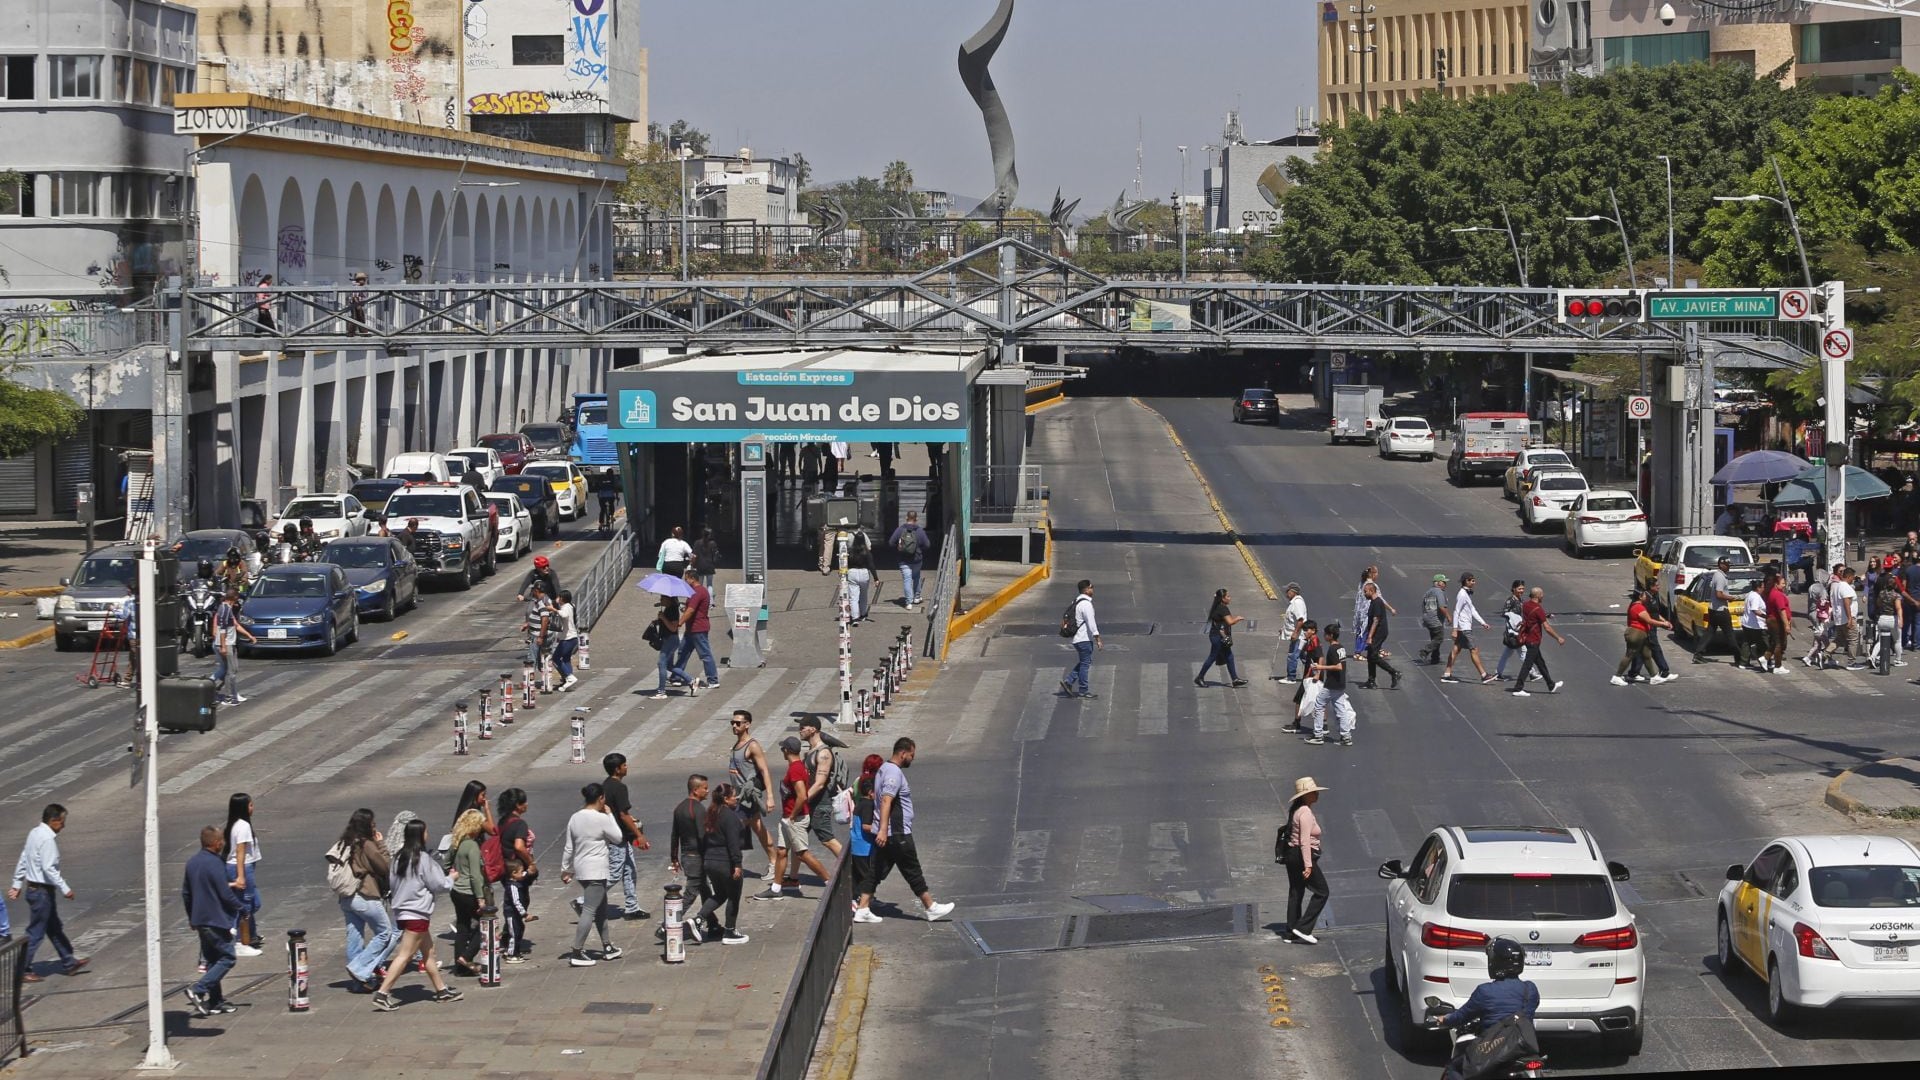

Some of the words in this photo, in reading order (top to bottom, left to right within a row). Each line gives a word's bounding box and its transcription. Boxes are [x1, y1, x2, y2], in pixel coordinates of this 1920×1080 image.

[468, 91, 551, 114] ZOMBY
[176, 107, 246, 130] 10FOOT
[1242, 211, 1278, 222] CENTRO
[1660, 301, 1680, 313] AV.
[1683, 301, 1727, 313] JAVIER
[1734, 301, 1767, 313] MINA
[745, 372, 797, 383] Estación
[799, 373, 845, 384] Express
[672, 397, 737, 422] San
[745, 397, 831, 422] Juan
[839, 396, 881, 422] de
[889, 396, 960, 422] Dios
[1635, 402, 1645, 410] 50
[800, 433, 838, 442] Mirador
[1869, 922, 1914, 931] 2063GMK
